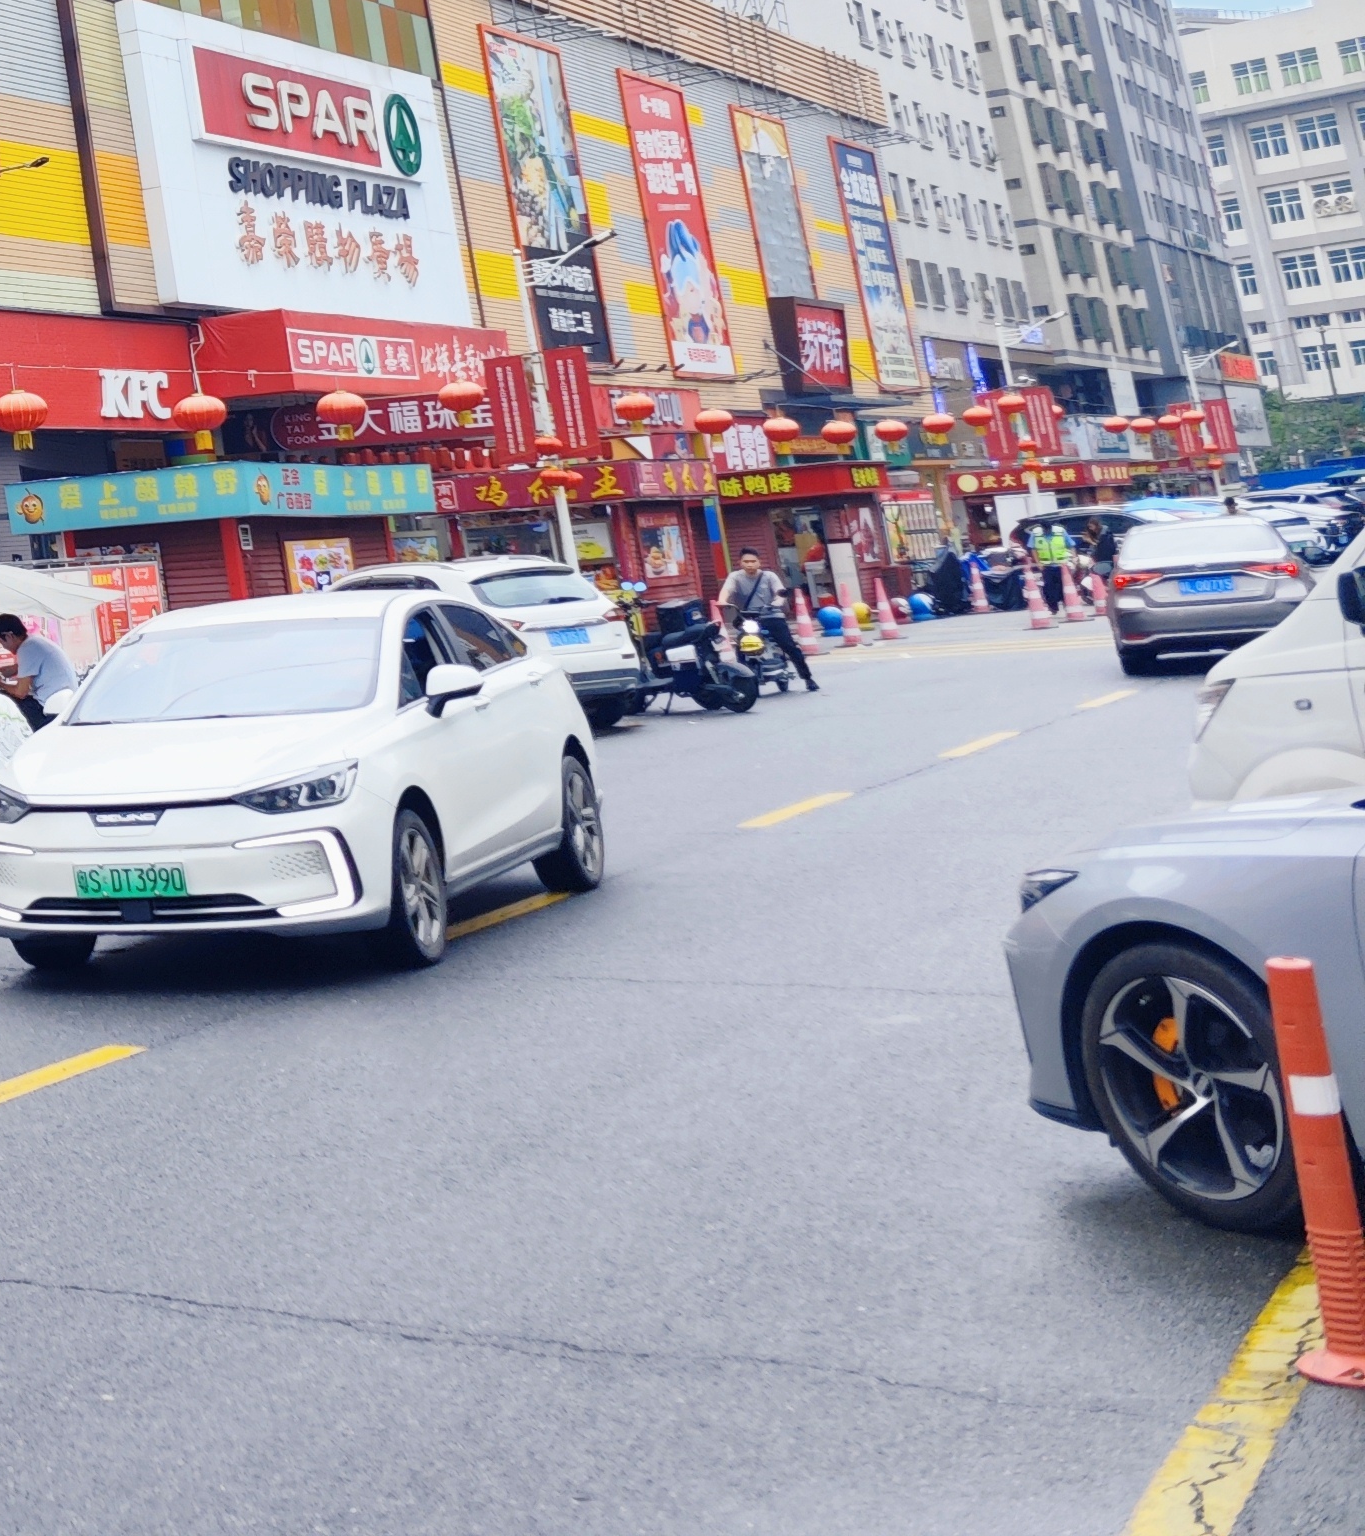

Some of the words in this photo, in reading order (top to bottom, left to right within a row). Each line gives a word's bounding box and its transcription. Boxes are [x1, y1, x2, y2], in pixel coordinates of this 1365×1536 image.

[239, 71, 380, 153] SPAR
[227, 156, 344, 210] SHOPPING
[346, 178, 411, 221] PLAZA
[297, 337, 355, 367] SPAR
[98, 368, 172, 420] KFC
[283, 412, 312, 424] KING
[285, 424, 305, 434] TAI
[286, 434, 318, 446] FOOK
